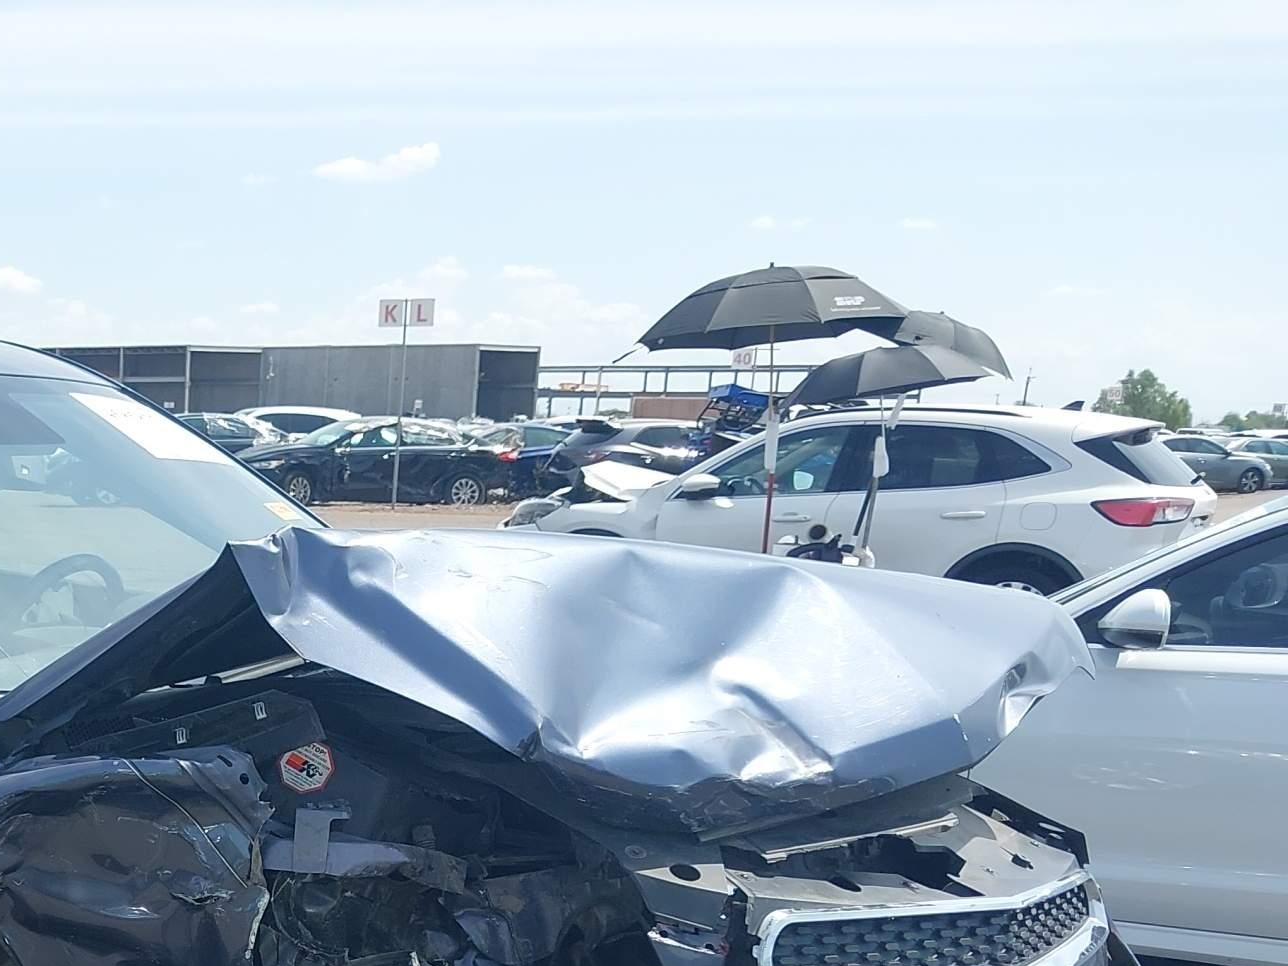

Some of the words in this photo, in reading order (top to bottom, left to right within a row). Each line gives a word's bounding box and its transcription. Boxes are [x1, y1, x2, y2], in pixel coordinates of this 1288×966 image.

[384, 304, 398, 323] K
[416, 303, 429, 322] L
[733, 352, 752, 365] 40
